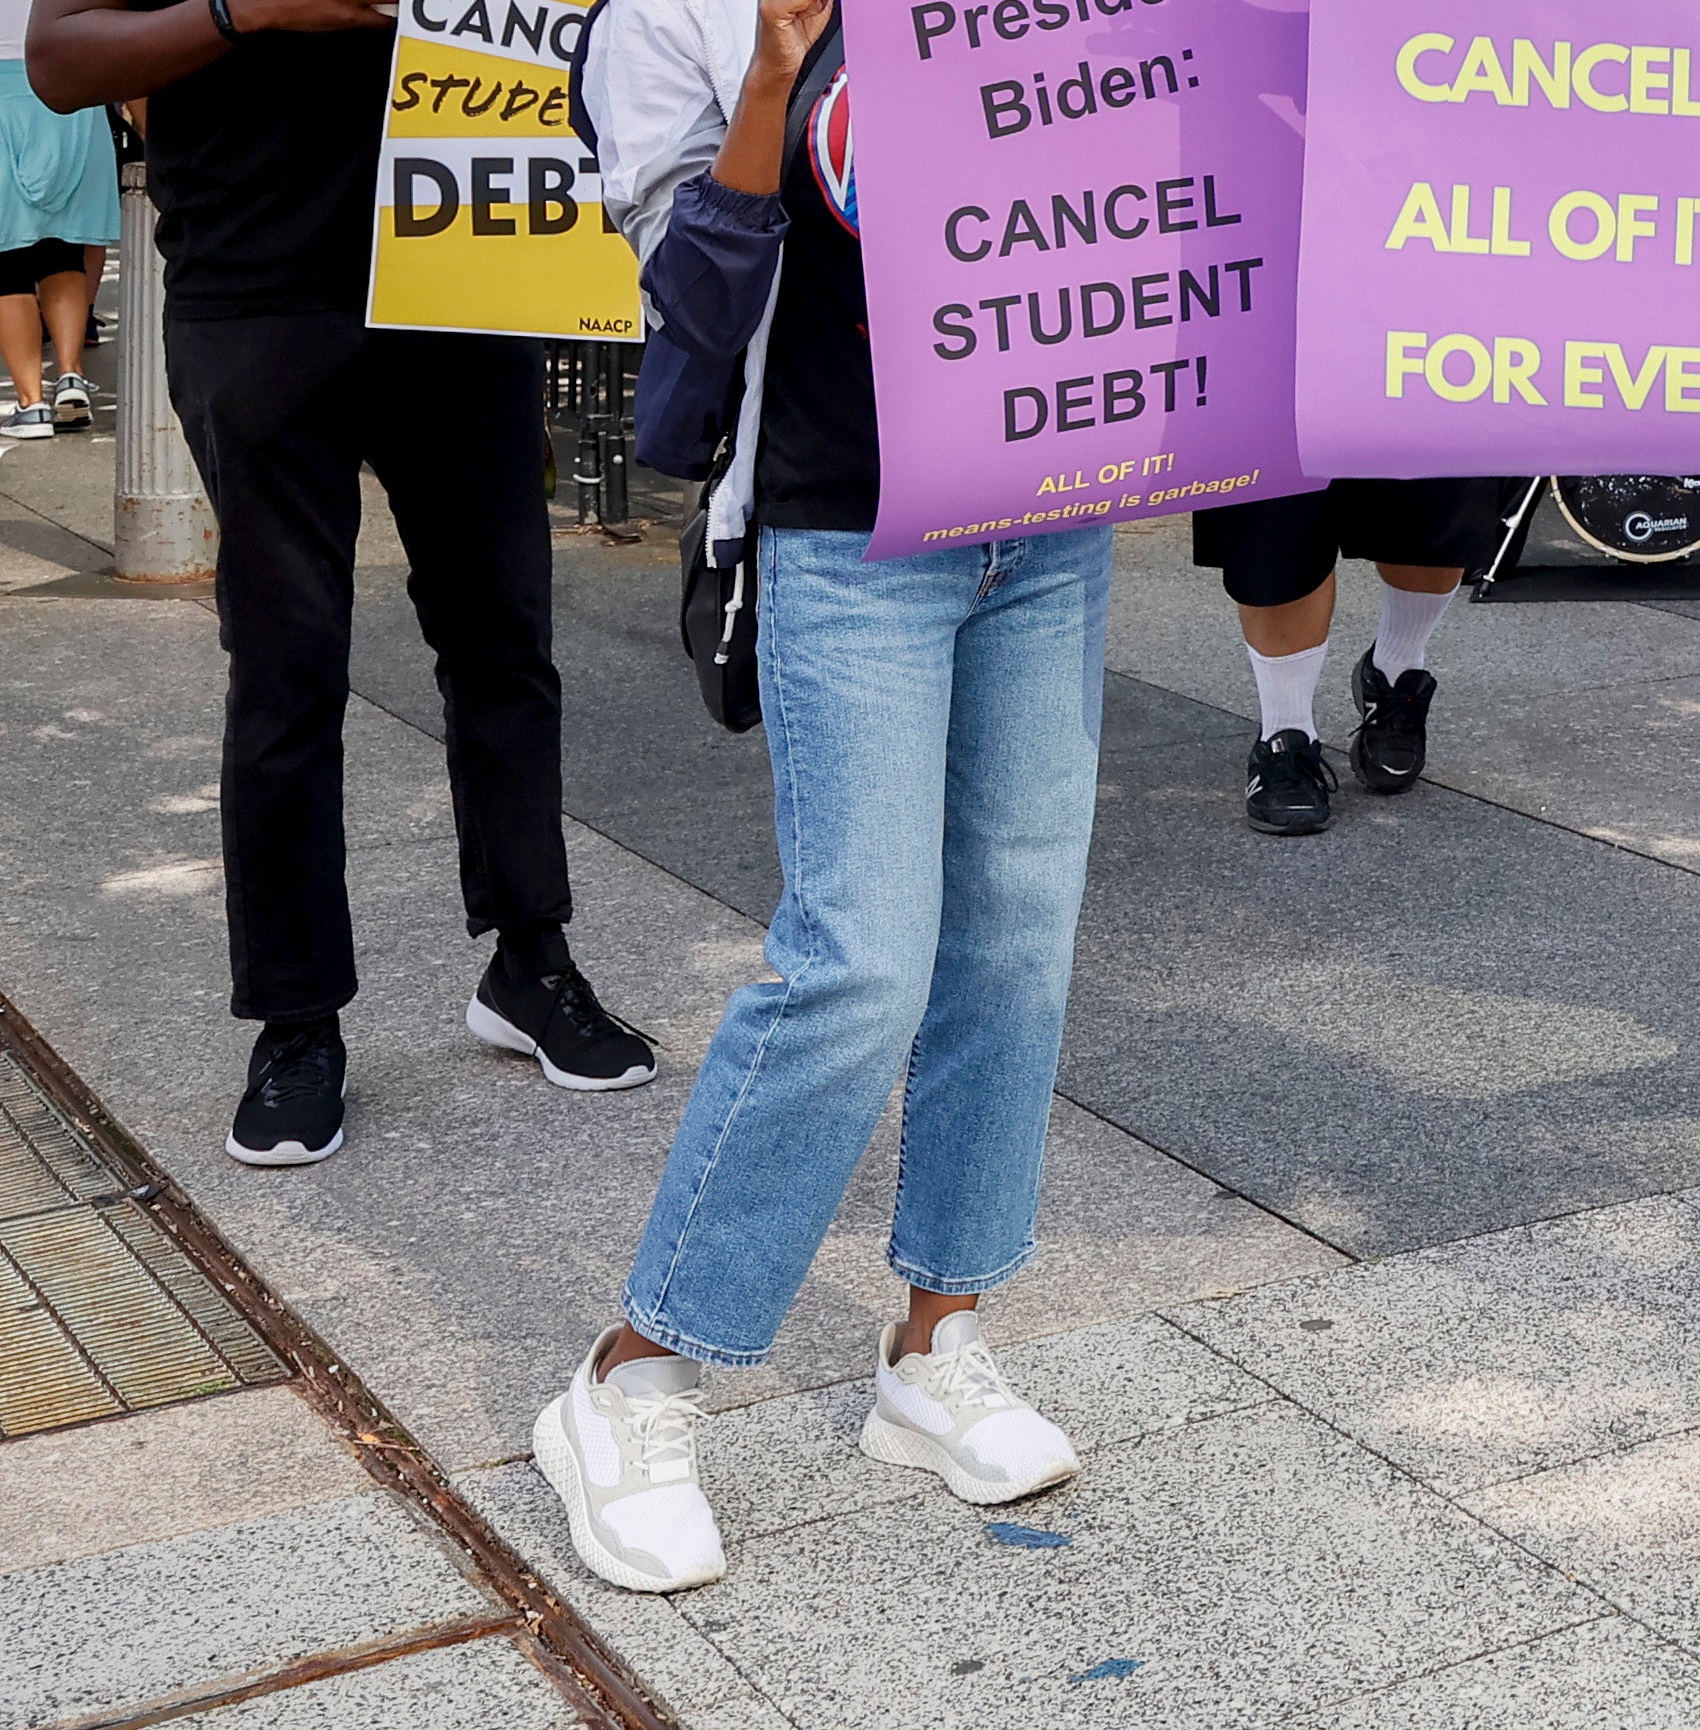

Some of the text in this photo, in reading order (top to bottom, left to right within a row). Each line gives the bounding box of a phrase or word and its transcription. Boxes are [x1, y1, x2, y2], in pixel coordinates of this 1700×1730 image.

[392, 72, 570, 127] STUDE
[979, 48, 1200, 140] Biden:
[944, 174, 1242, 263] CANCEL
[1385, 181, 1532, 257] ALL
[1547, 190, 1660, 263] OF
[579, 316, 633, 333] NAACP
[932, 258, 1264, 361] STUDENT
[1003, 356, 1208, 443] DEBT!
[1385, 330, 1548, 406] FOR
[922, 470, 1260, 542] means-testing is garbage!
[1036, 453, 1174, 496] ALL OF IT!
[1635, 517, 1687, 529] AQUARIAN
